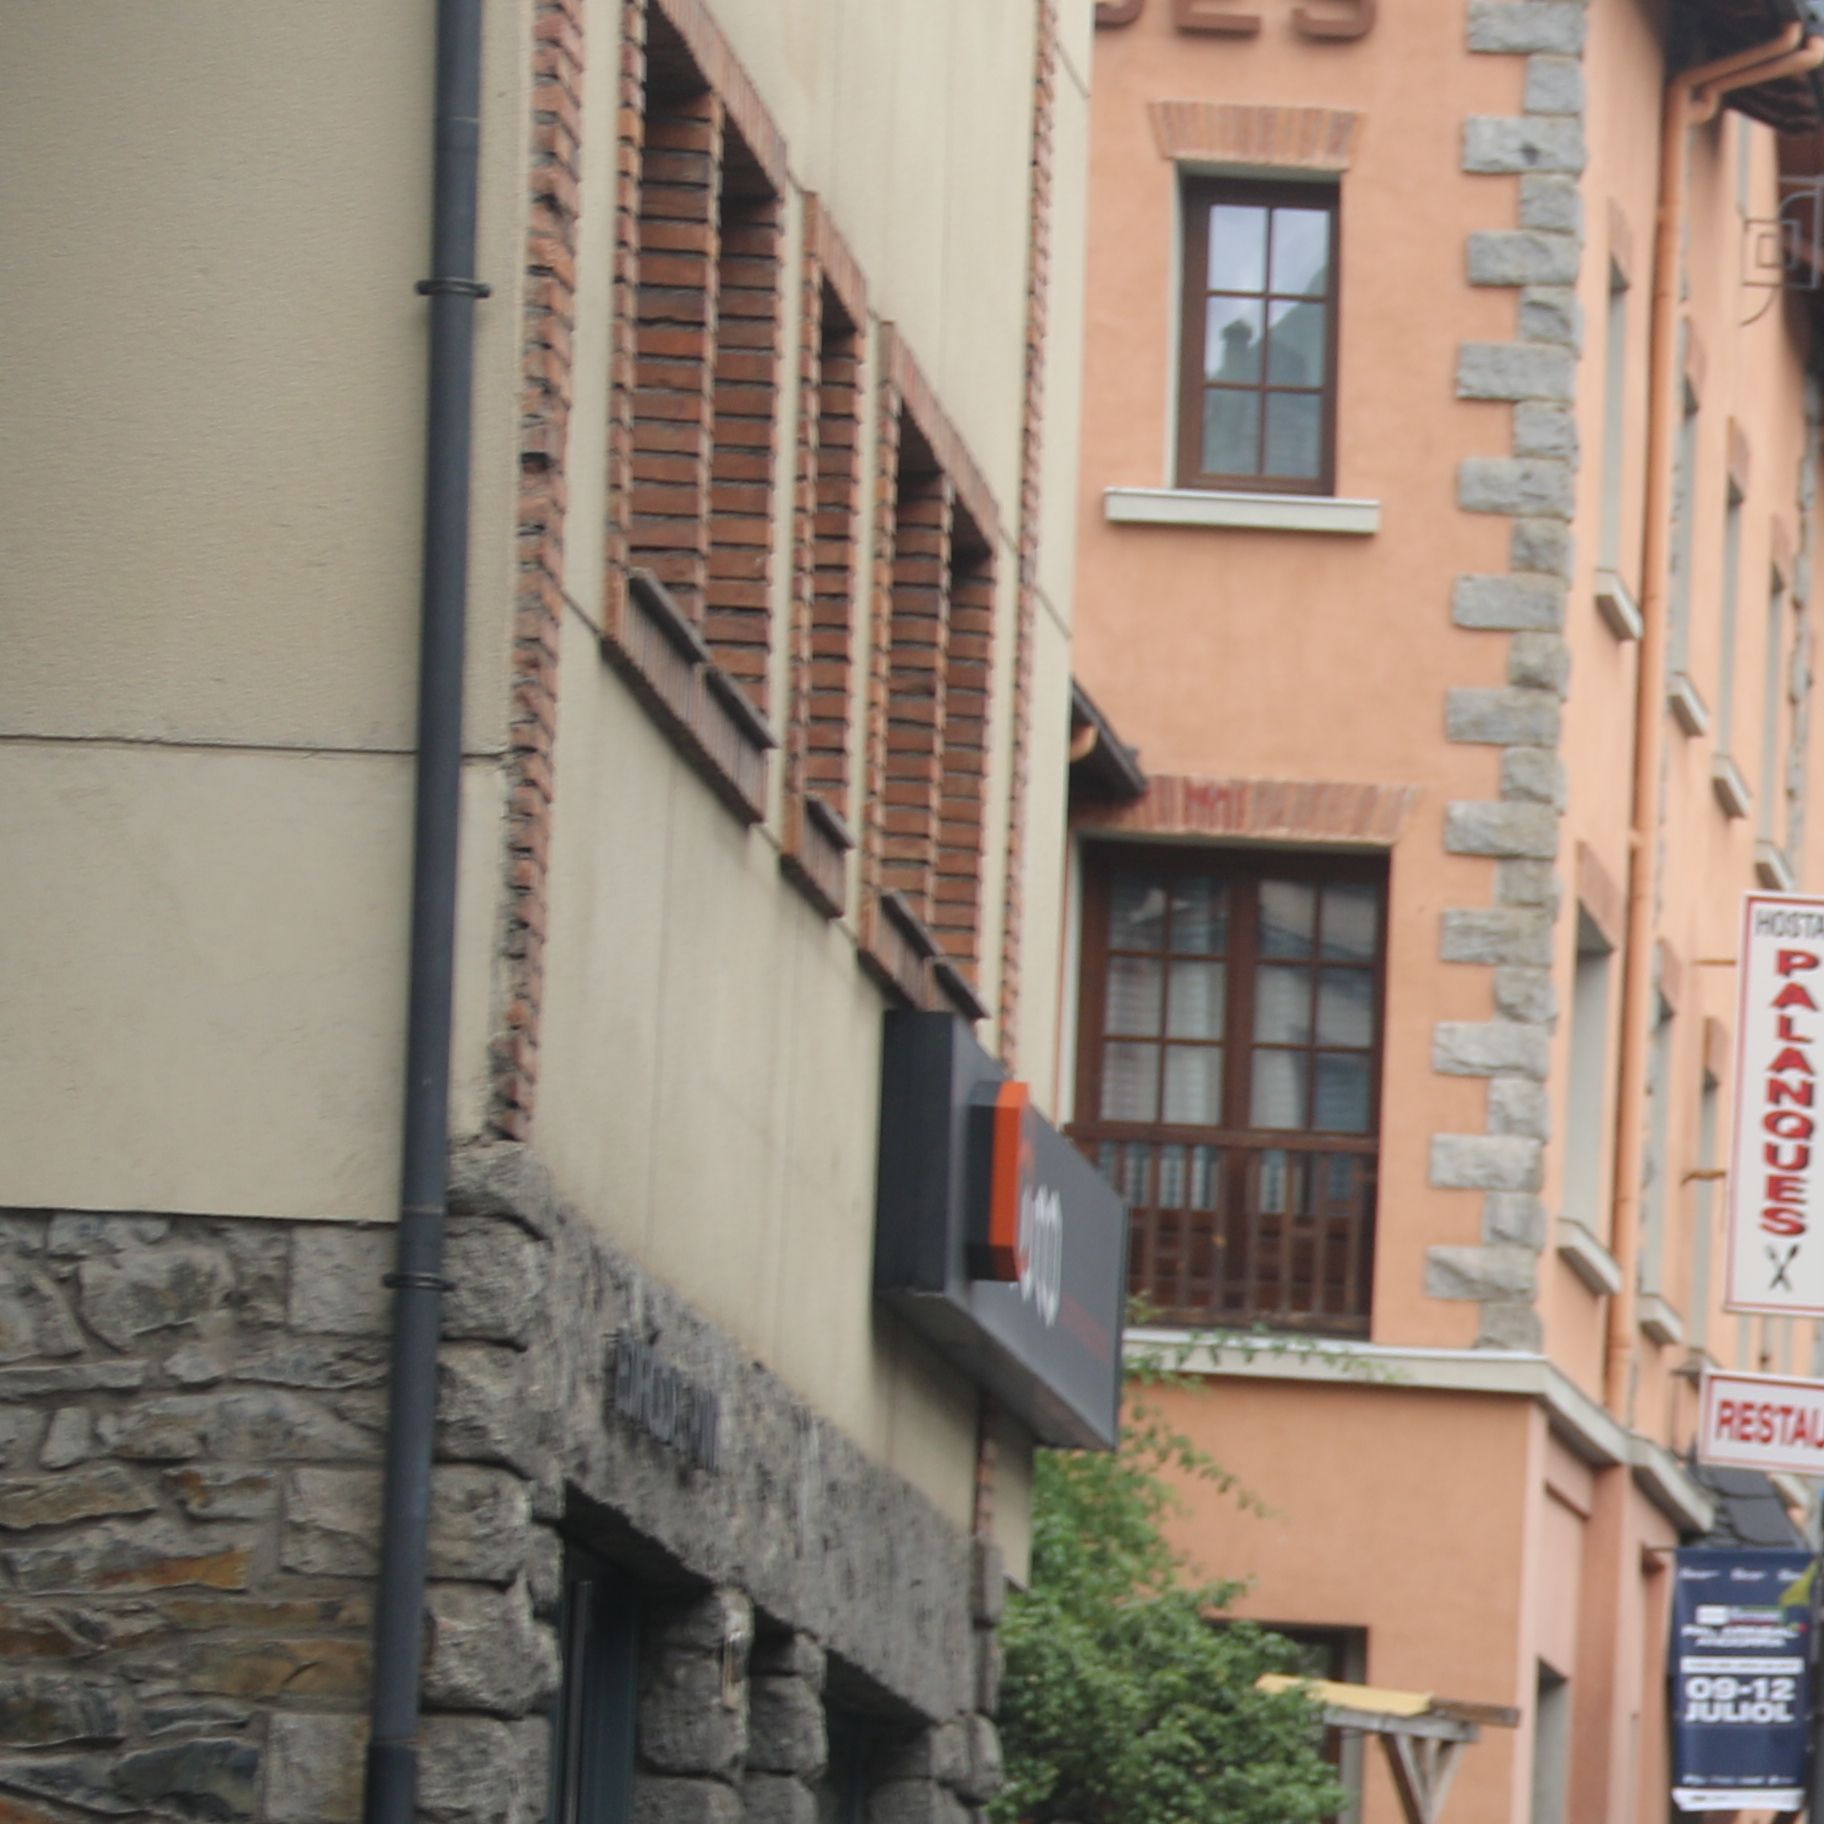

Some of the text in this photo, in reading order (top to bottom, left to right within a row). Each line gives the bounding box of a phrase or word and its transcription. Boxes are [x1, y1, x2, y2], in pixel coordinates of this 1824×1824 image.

[1760, 949, 1820, 1237] PALANQUES
[1684, 1676, 1796, 1701] 09-12
[1684, 1701, 1796, 1723] JULIOL
